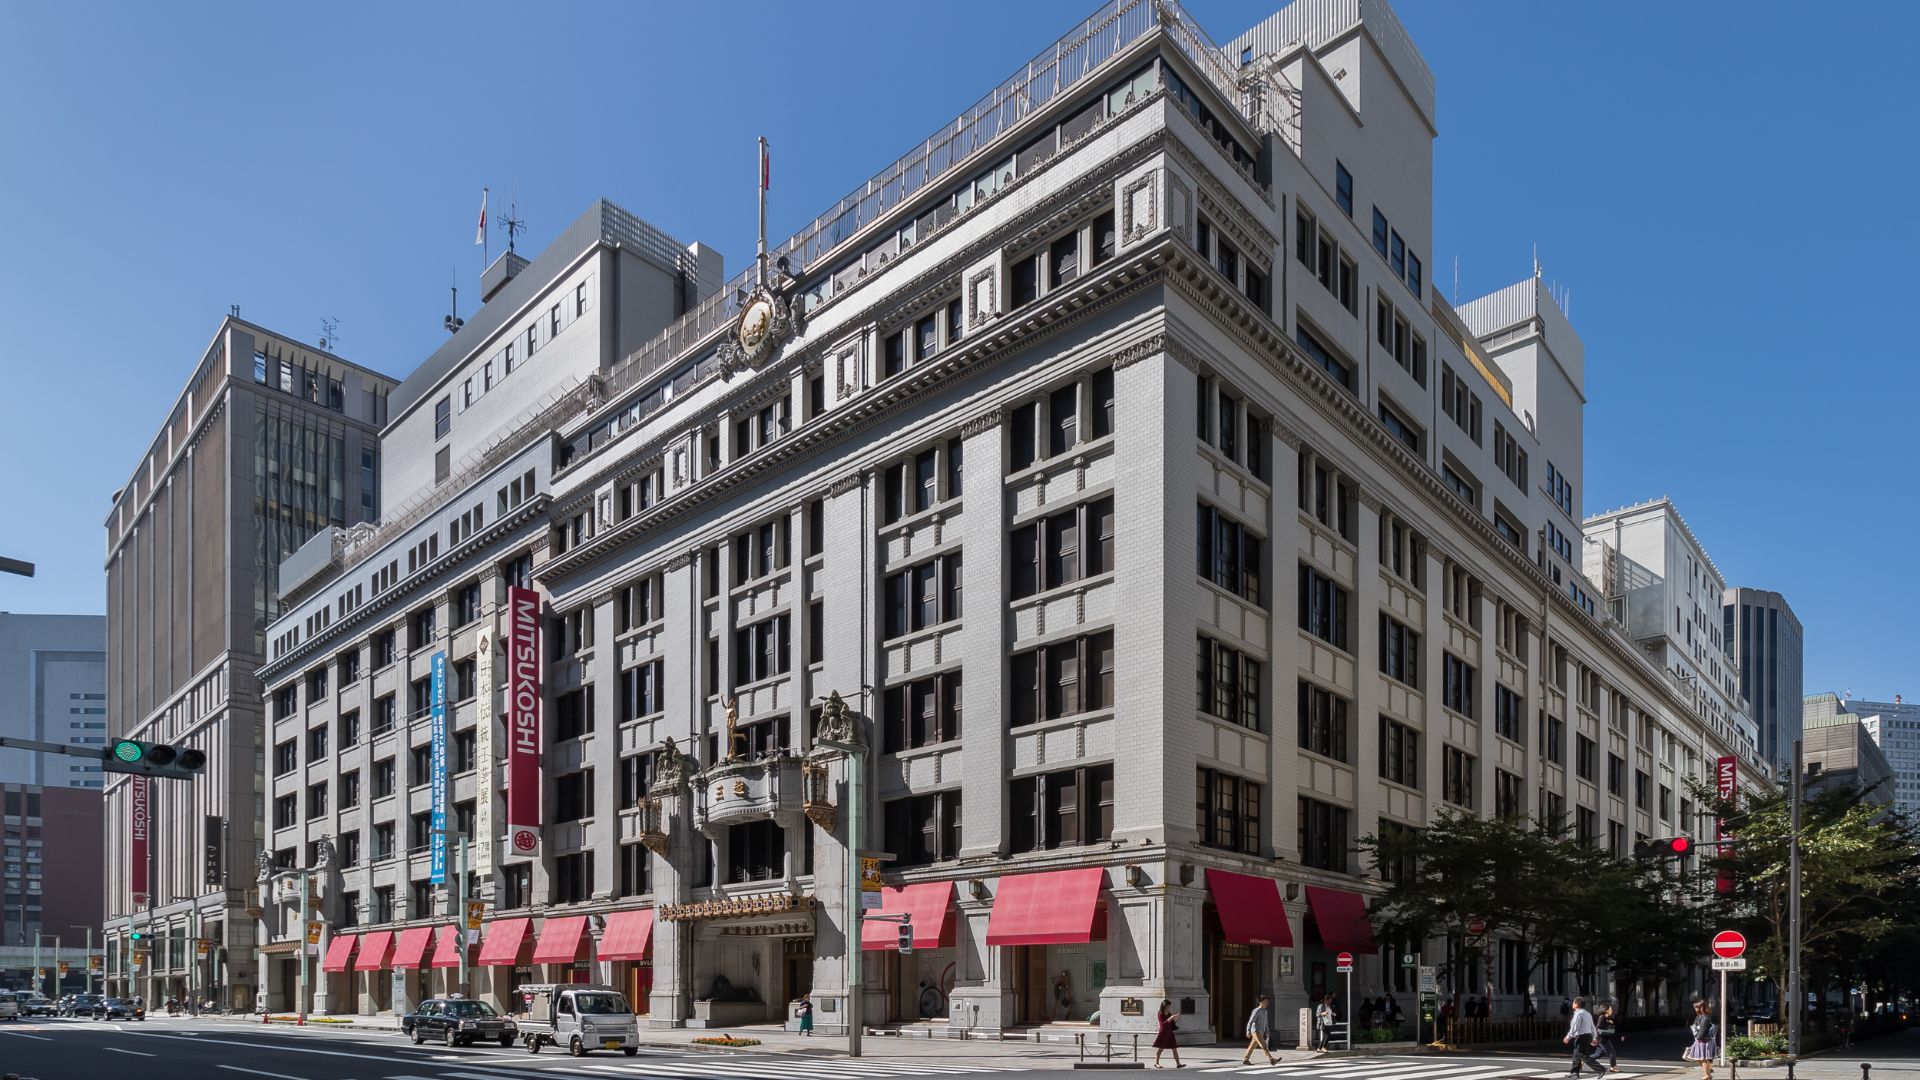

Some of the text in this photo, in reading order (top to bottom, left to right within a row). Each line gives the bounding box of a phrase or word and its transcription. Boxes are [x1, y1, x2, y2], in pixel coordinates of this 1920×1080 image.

[480, 661, 489, 805] 日本伝統工芸展
[517, 599, 535, 755] MITSUKOSHI
[715, 780, 746, 801] 三越
